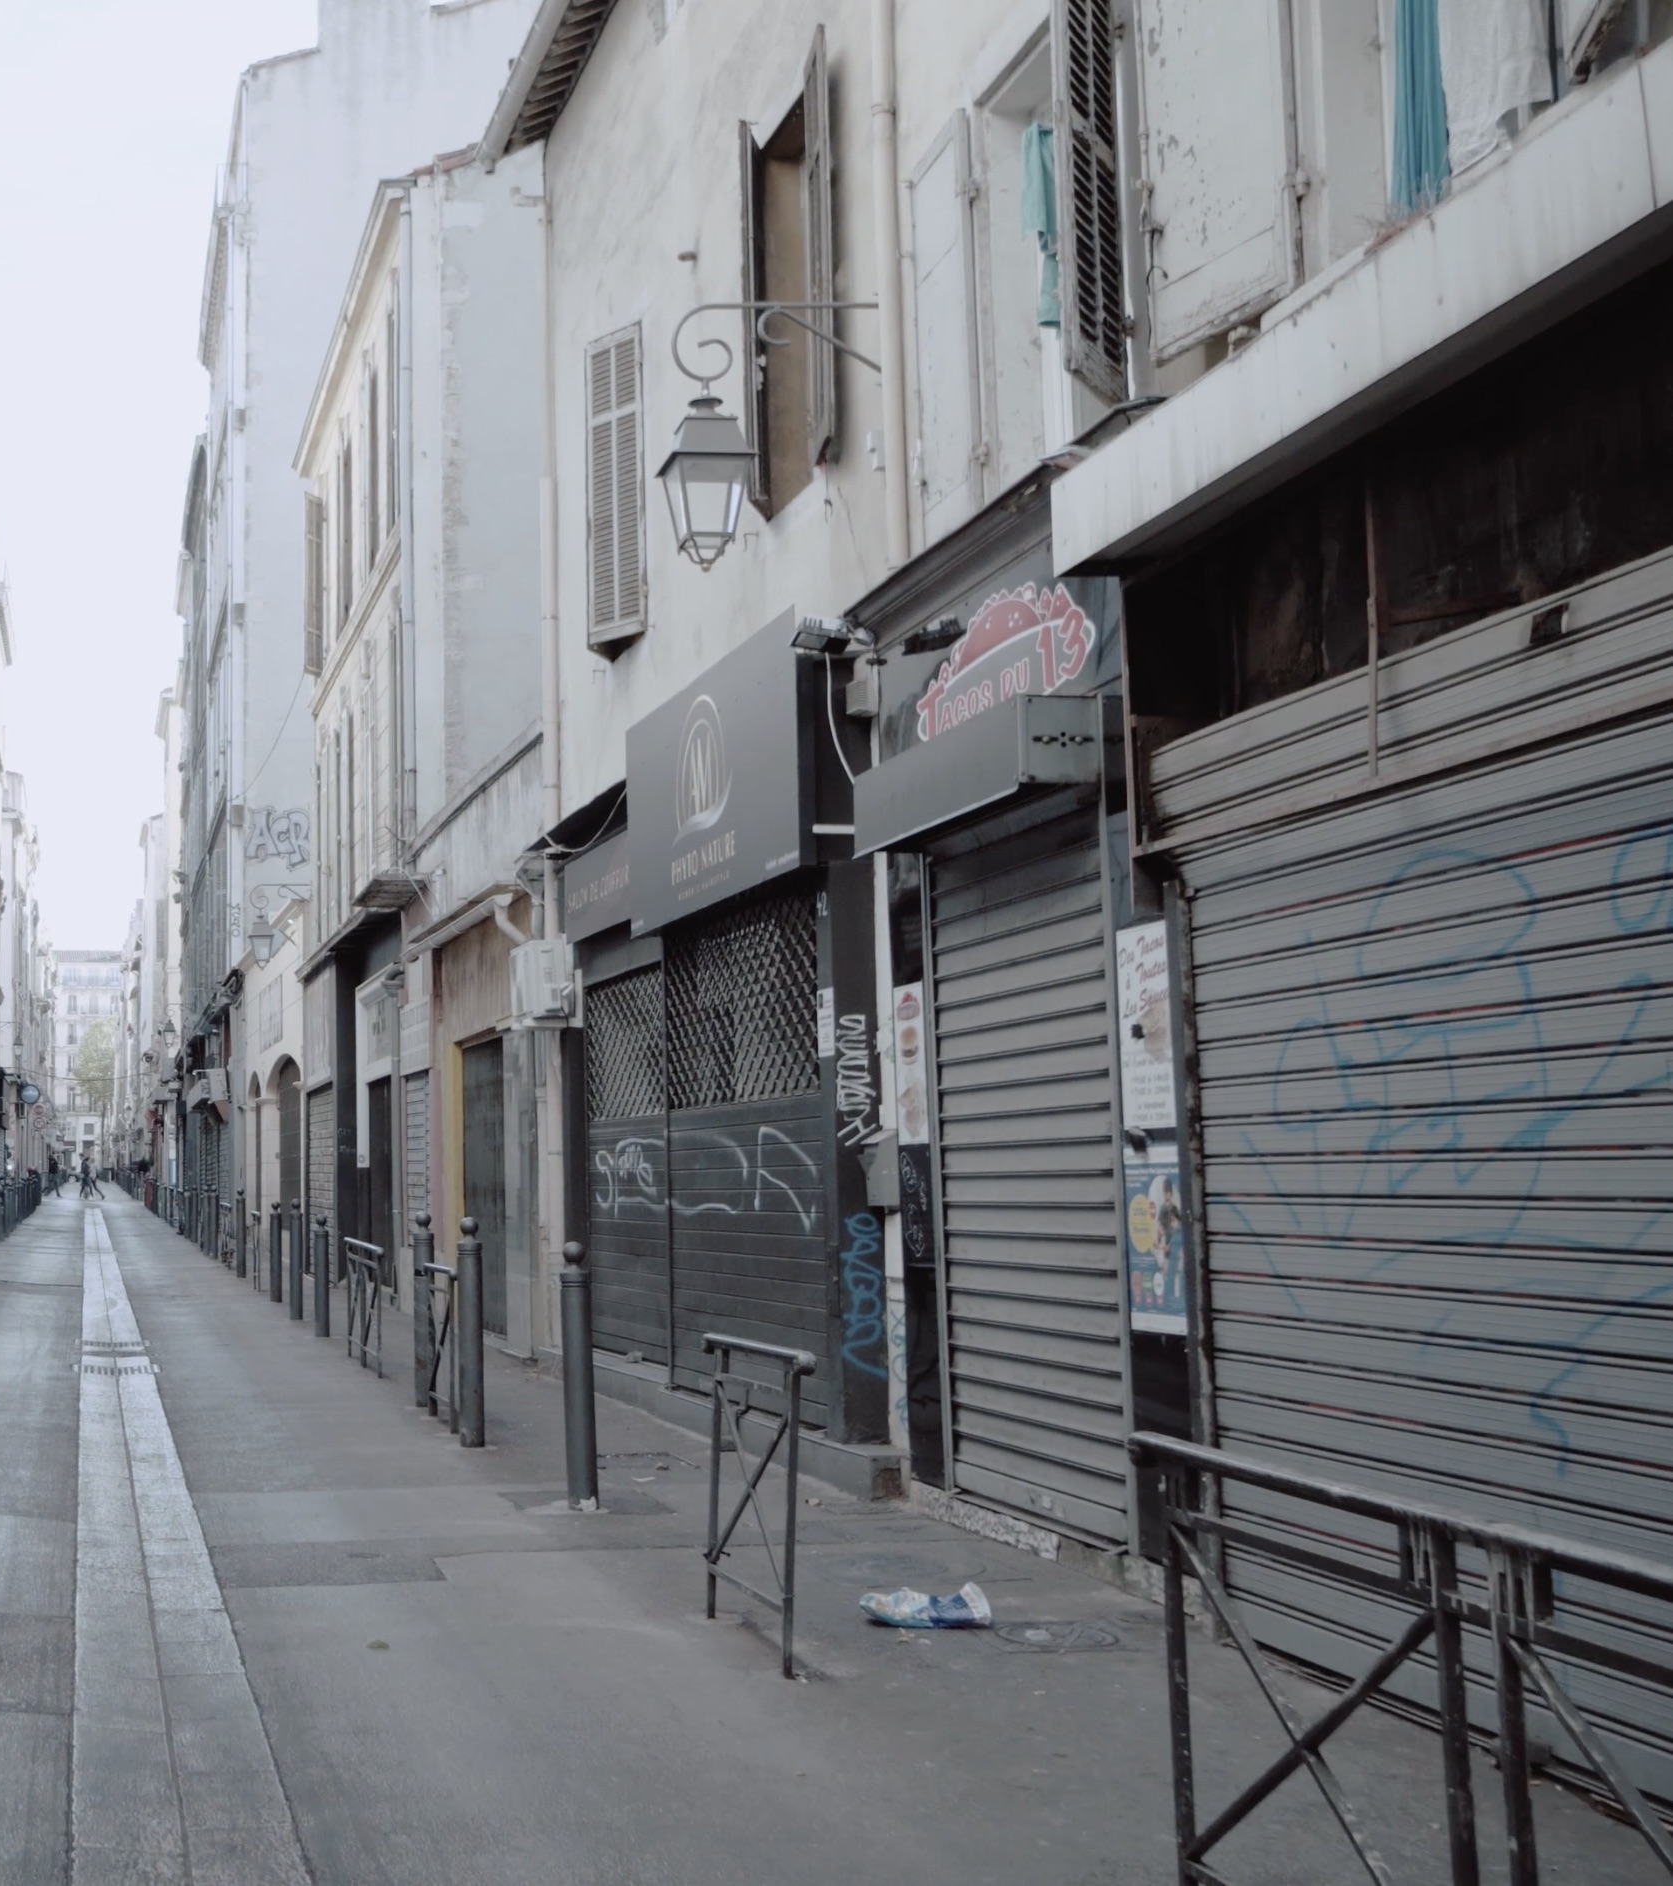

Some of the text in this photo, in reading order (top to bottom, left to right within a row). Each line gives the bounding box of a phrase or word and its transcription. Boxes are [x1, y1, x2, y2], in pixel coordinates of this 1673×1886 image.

[917, 607, 1087, 742] TACOS DU 13
[671, 848, 698, 887] PHYTO
[700, 829, 736, 871] NATURE
[567, 886, 588, 915] SALON
[589, 879, 598, 903] DE
[816, 891, 829, 918] 42
[1118, 934, 1165, 970] Des Tacos
[1122, 998, 1138, 1019] Les
